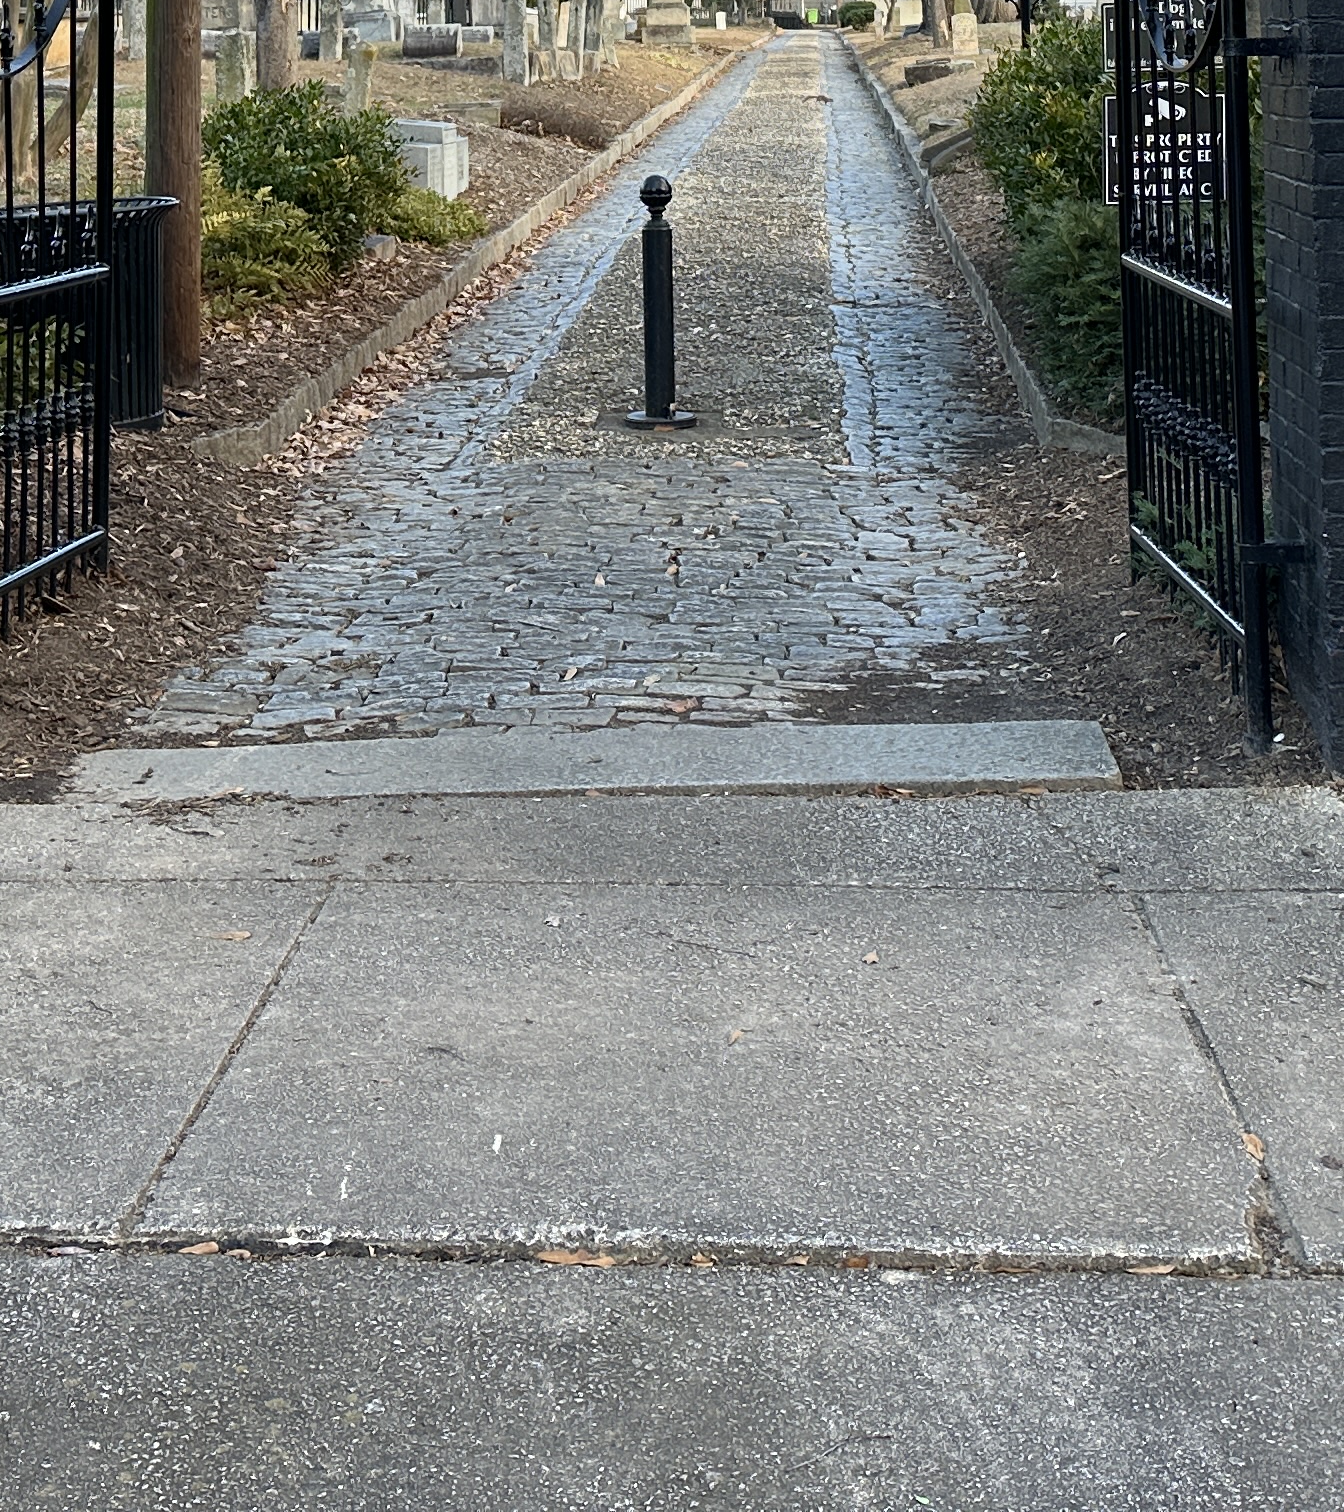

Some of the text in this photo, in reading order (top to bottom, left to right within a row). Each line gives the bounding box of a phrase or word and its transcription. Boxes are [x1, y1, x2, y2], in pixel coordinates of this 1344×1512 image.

[1158, 1, 1193, 17] Dog
[1109, 134, 1138, 148] TS
[1133, 149, 1212, 164] PROTCED
